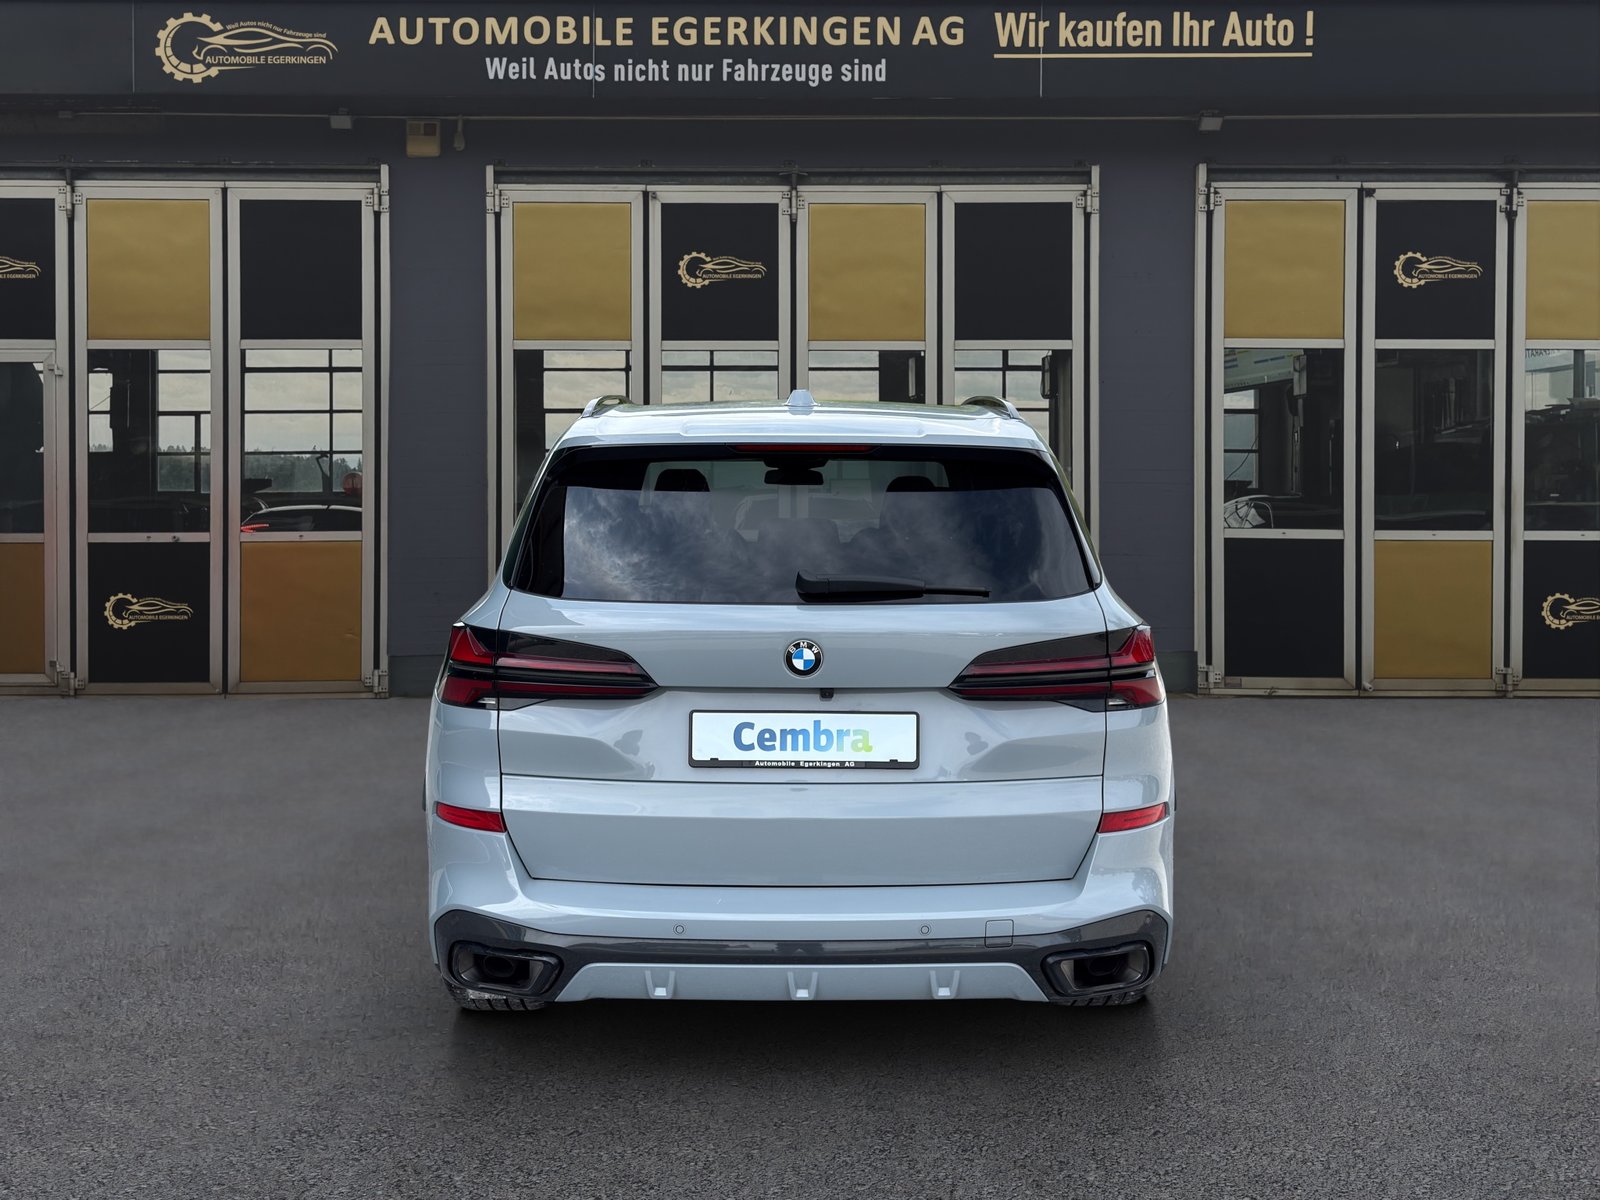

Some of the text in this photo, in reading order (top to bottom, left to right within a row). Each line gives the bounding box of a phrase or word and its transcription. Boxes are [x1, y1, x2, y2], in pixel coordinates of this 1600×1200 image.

[226, 22, 239, 30] Weil
[257, 21, 273, 29] nicht
[272, 25, 283, 33] nur
[283, 28, 313, 38] Fahrzeuge
[368, 15, 965, 46] AUTOMOBILE EGERKINGEN AG
[994, 12, 1050, 48] Wir
[1058, 11, 1162, 48] kaufen
[1172, 11, 1216, 47] Ihr
[1222, 11, 1295, 47] Auto
[205, 55, 326, 64] AUTOMOBILE EGERKINGEN
[485, 56, 887, 88] Weil Autos nicht nur Fahrzeuge sind
[788, 641, 820, 654] BMW
[733, 719, 873, 753] Cembra
